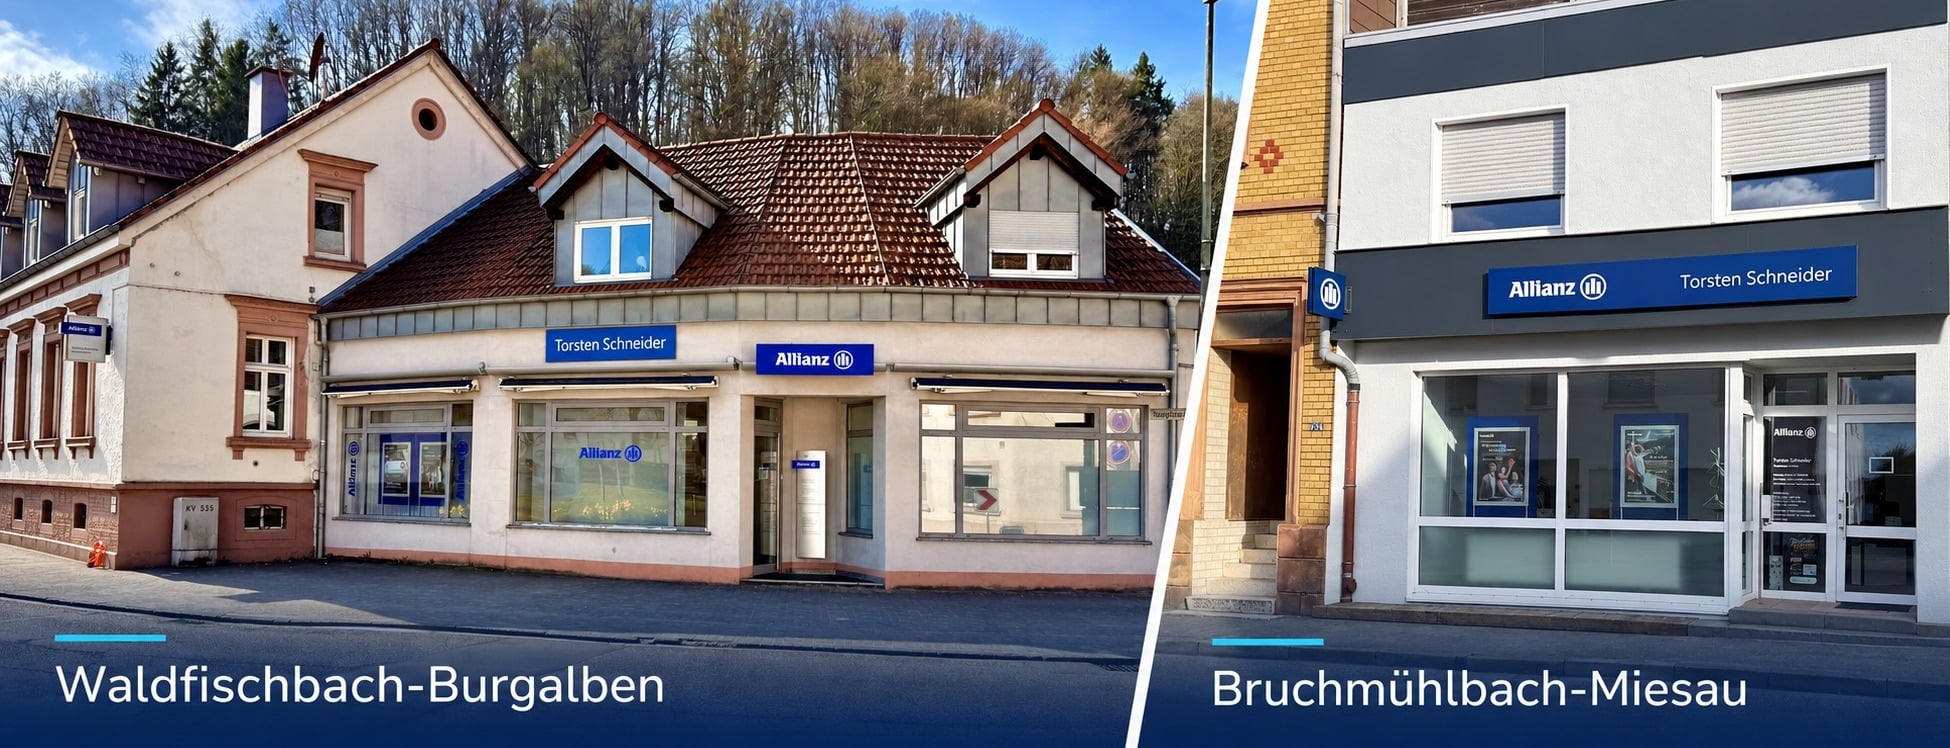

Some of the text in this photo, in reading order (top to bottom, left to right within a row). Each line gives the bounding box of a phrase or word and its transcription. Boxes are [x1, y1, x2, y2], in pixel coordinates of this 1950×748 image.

[1680, 266, 1833, 289] Torsten Schneider
[1508, 280, 1576, 298] Allianz
[555, 336, 667, 352] Torsten Schneider
[775, 352, 830, 366] Allianz
[1773, 427, 1805, 437] Allianz
[579, 447, 622, 459] Allianz
